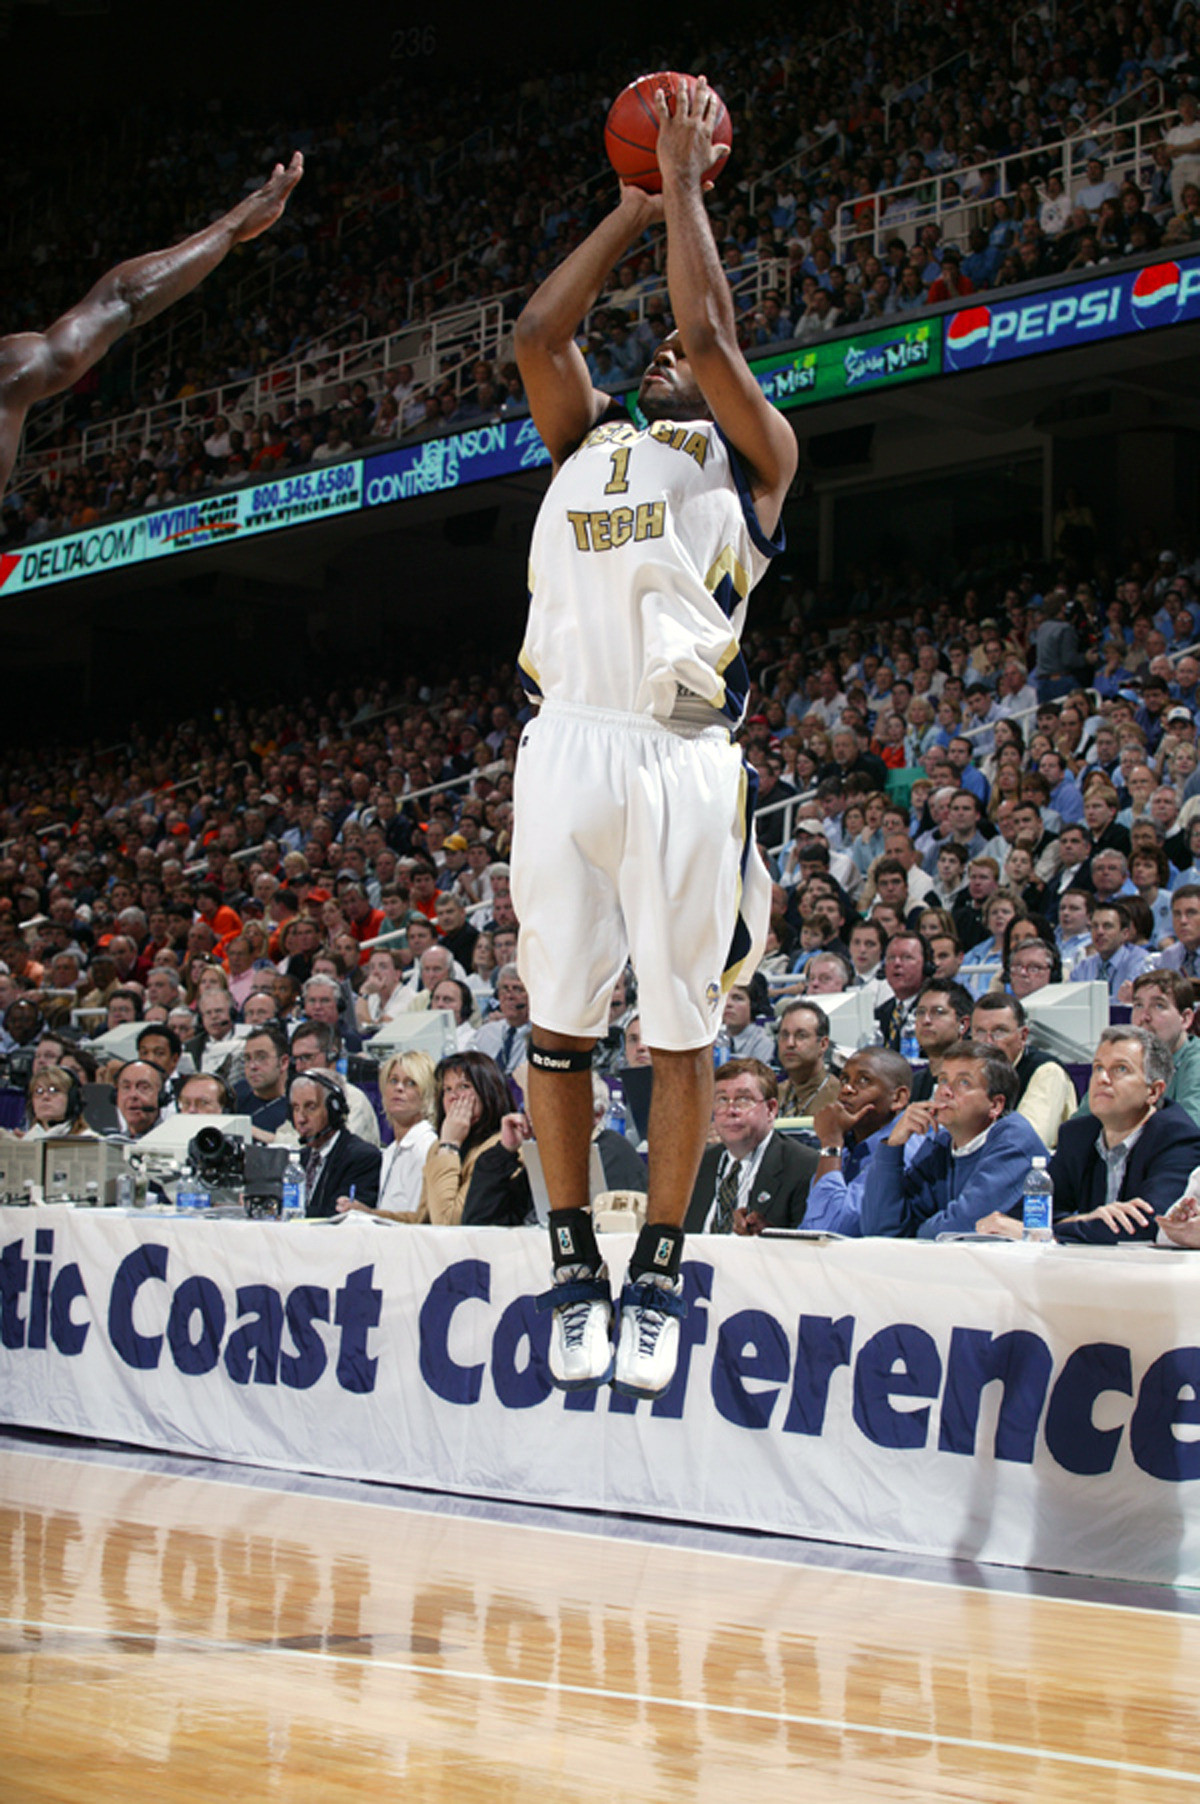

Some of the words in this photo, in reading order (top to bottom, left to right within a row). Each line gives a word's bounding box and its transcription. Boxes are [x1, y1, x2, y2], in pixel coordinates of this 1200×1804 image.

[390, 24, 436, 59] 236
[988, 286, 1121, 349] PEPSI
[884, 338, 929, 373] Mist
[773, 366, 815, 398] Mist
[412, 423, 507, 471] JOHNSON
[252, 465, 356, 512] 800.345.6580
[367, 460, 460, 506] CONTROLS
[603, 447, 631, 496] 1
[567, 501, 666, 552] TECH
[22, 525, 138, 583] DELTACOM
[107, 1243, 383, 1394] Coast
